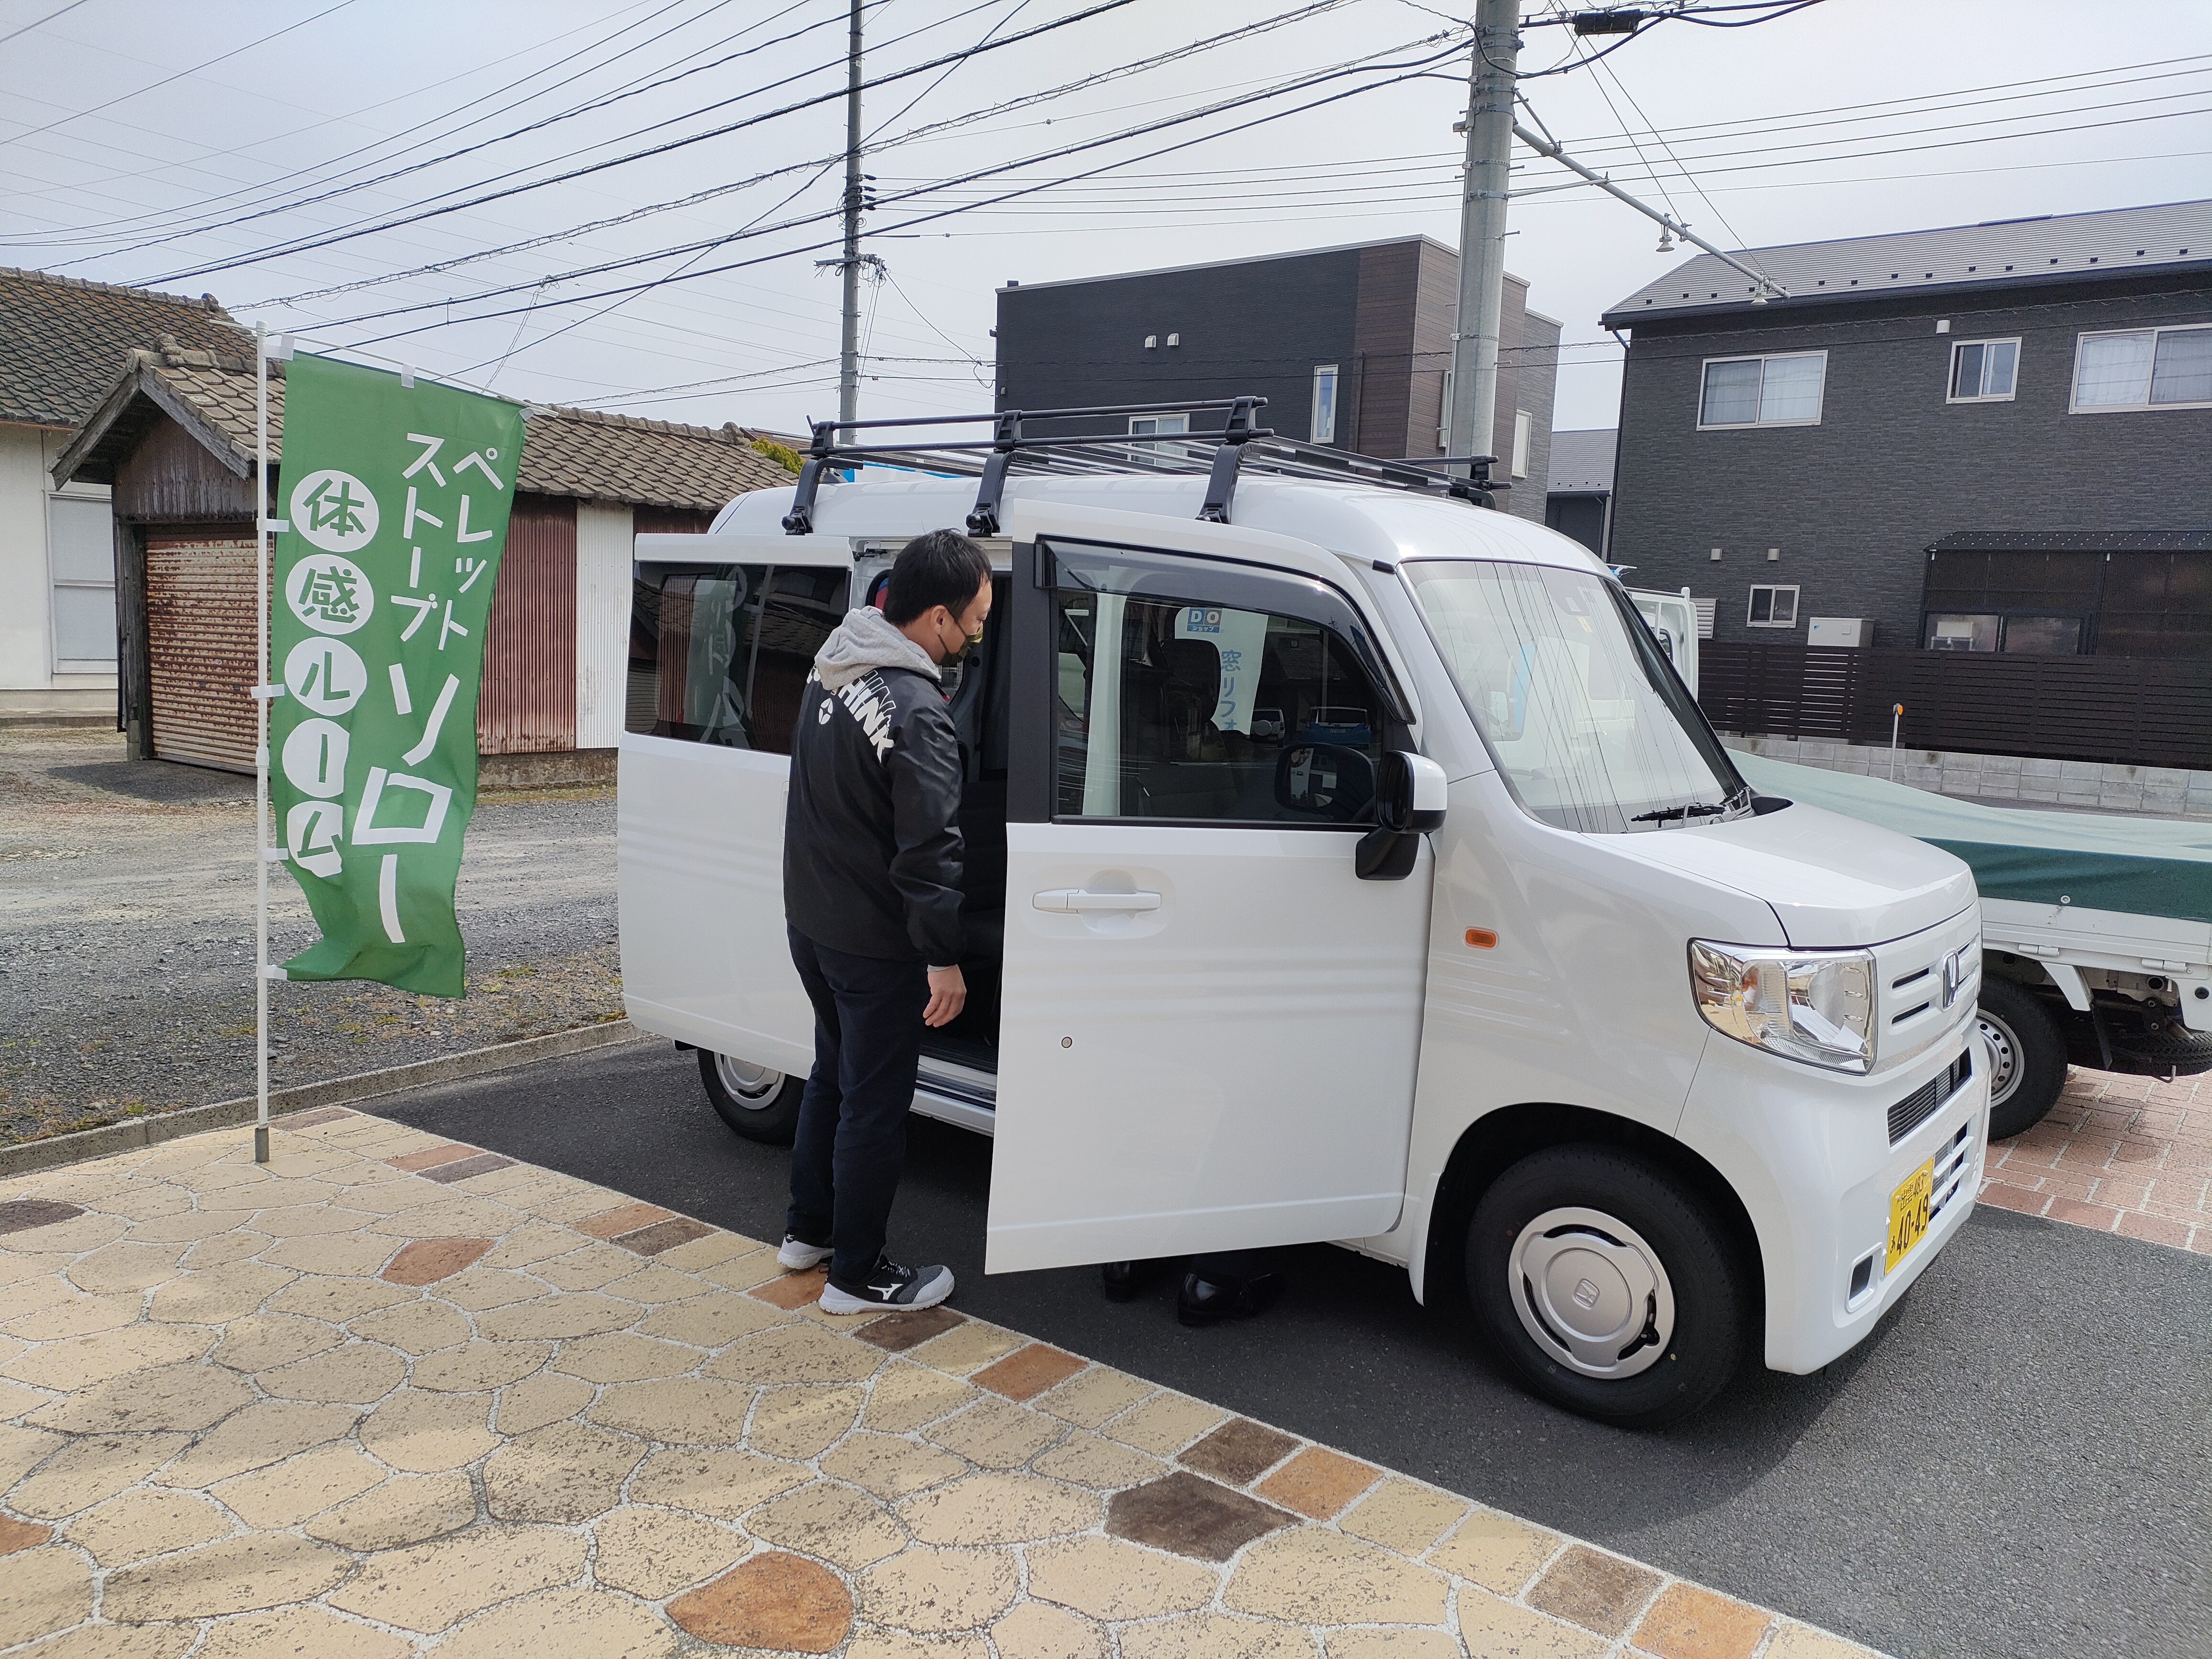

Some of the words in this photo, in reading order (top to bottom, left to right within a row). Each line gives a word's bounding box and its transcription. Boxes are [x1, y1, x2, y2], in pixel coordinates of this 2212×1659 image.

[390, 431, 447, 642] ストーブ
[438, 447, 504, 651] ペレット
[297, 480, 368, 859] 体感ルーム
[352, 662, 460, 943] ソロー
[1896, 1193, 1929, 1255] 40-49
